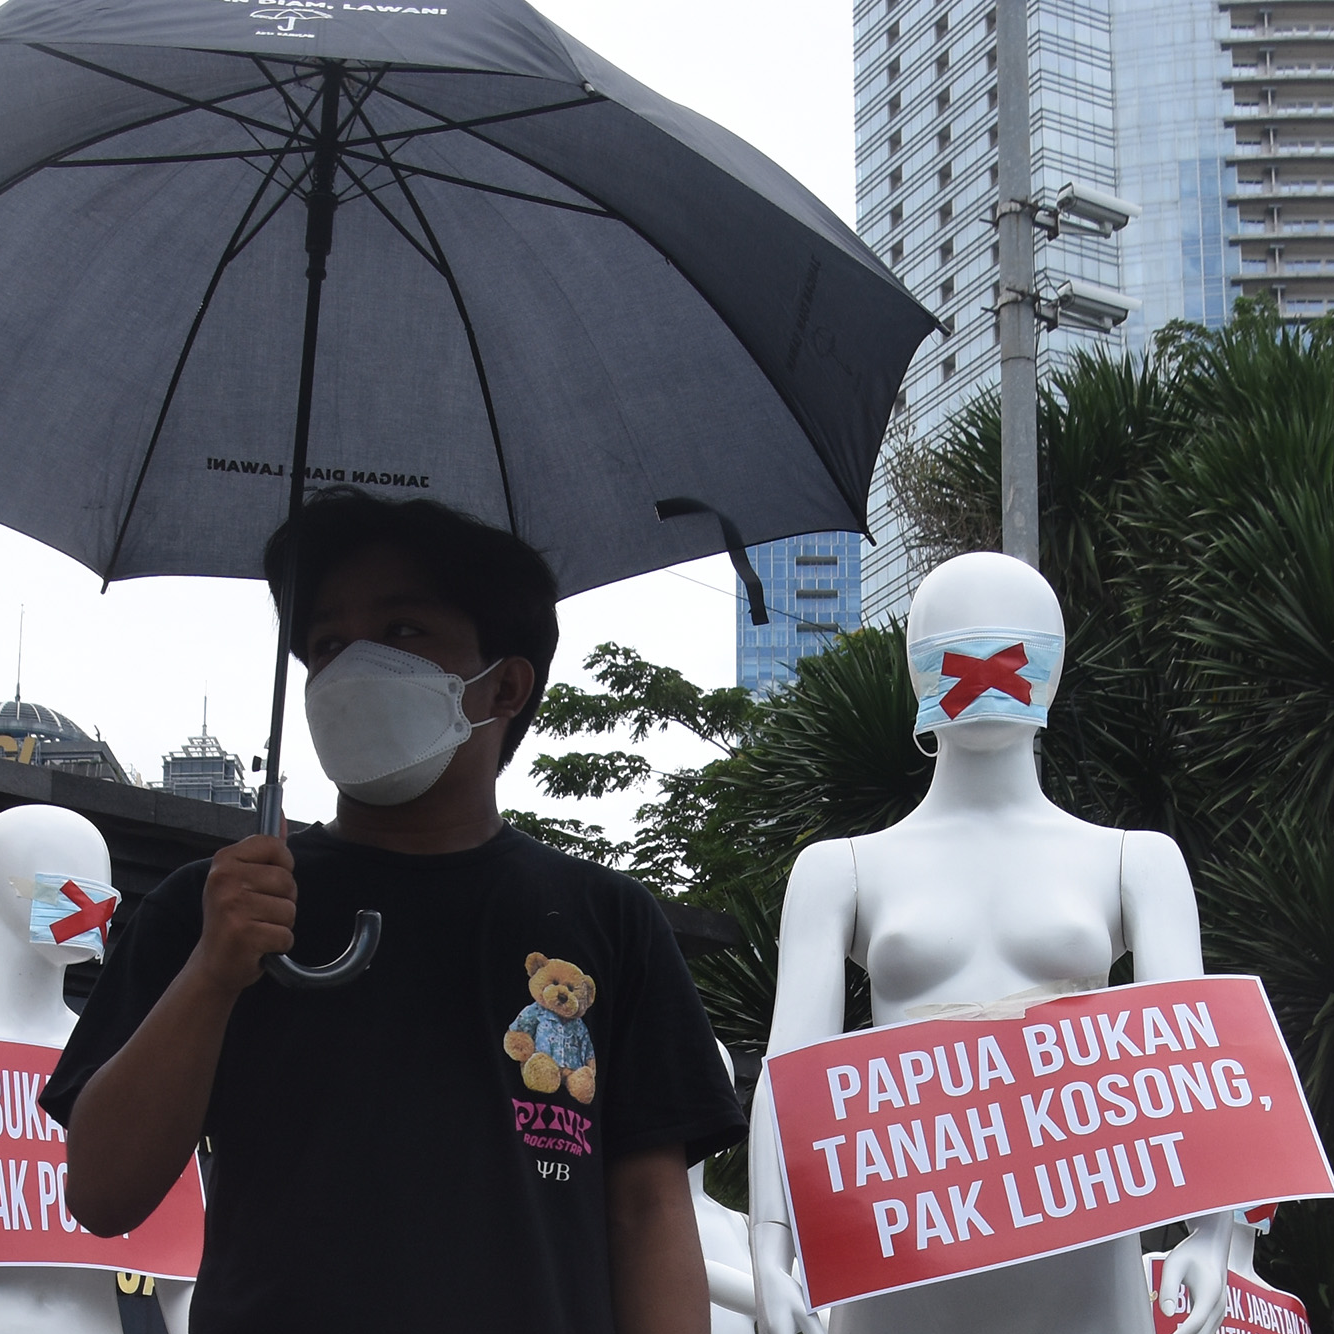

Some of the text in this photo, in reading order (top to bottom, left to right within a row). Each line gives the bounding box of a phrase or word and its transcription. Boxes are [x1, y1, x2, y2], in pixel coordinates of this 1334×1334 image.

[343, 3, 448, 16] LAWAN!
[826, 1000, 1219, 1120] PAPUA BUKAN
[511, 1098, 593, 1155] PINK
[523, 1133, 583, 1157] ROCKSTAR
[813, 1059, 1273, 1193] TANAH KOSONG,
[873, 1131, 1186, 1257] PAK LUHUT
